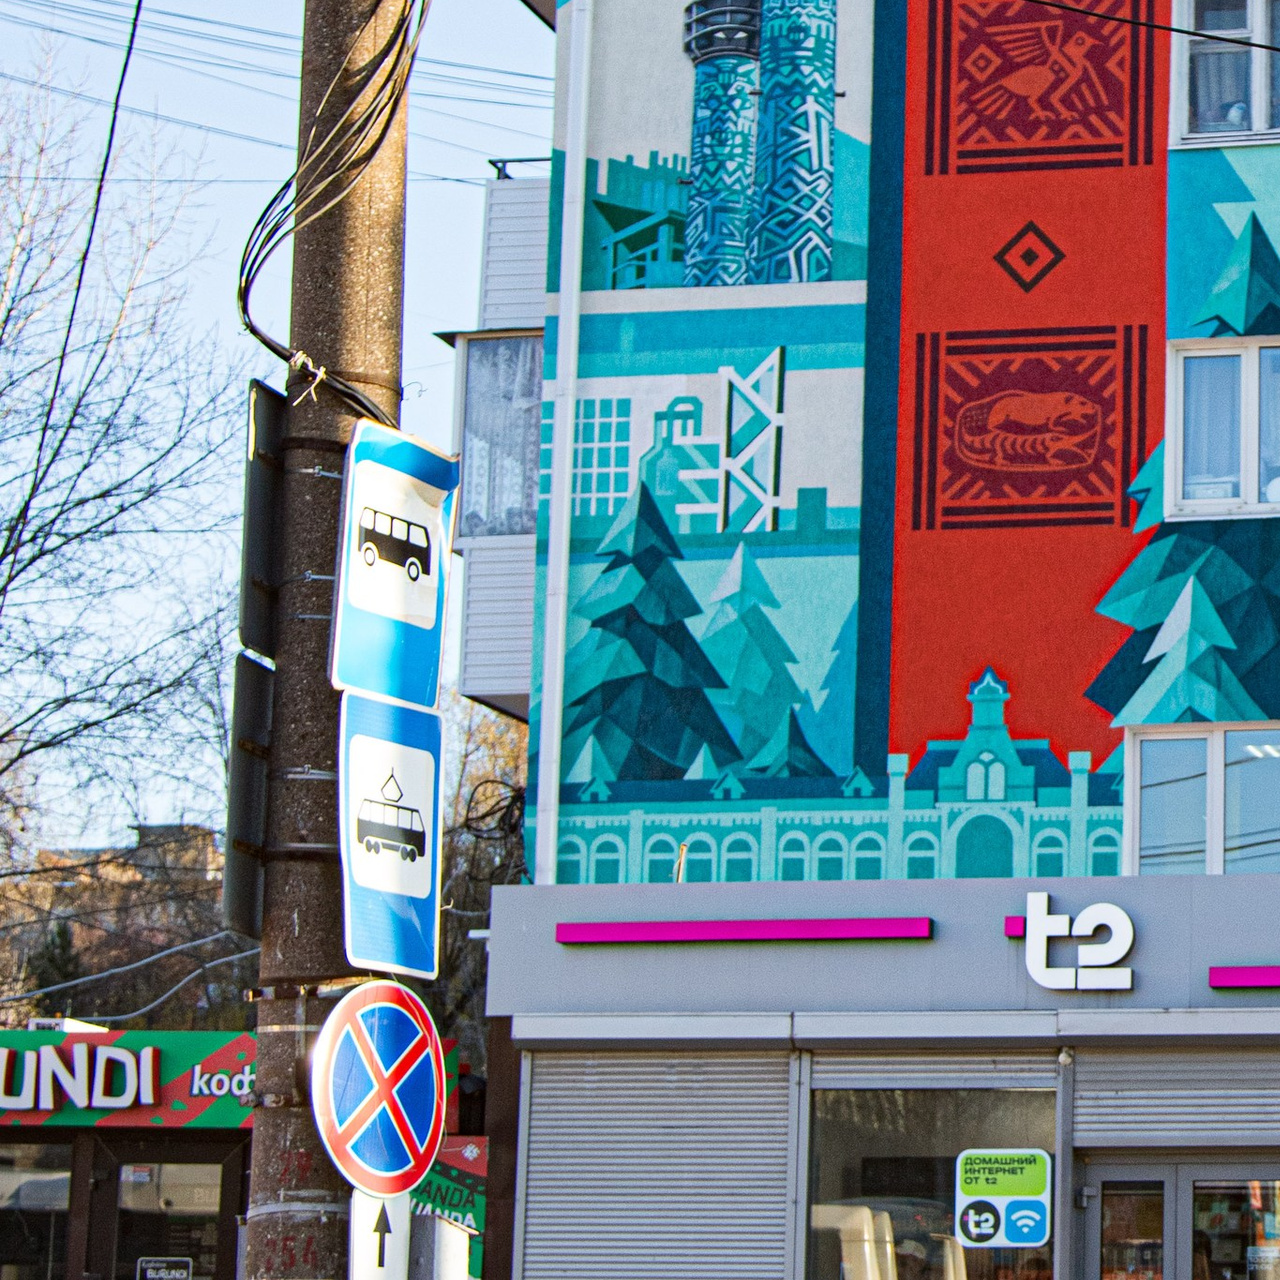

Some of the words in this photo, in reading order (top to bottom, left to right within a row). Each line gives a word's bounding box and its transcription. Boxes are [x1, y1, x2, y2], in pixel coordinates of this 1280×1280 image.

[1006, 891, 1134, 990] t2
[964, 1155, 1037, 1166] ДОМАШНИЙ
[964, 1166, 1025, 1175] ИНТЕРНЕТ
[964, 1177, 980, 1185] ОТ
[985, 1177, 998, 1185] t2
[963, 1208, 995, 1235] t2
